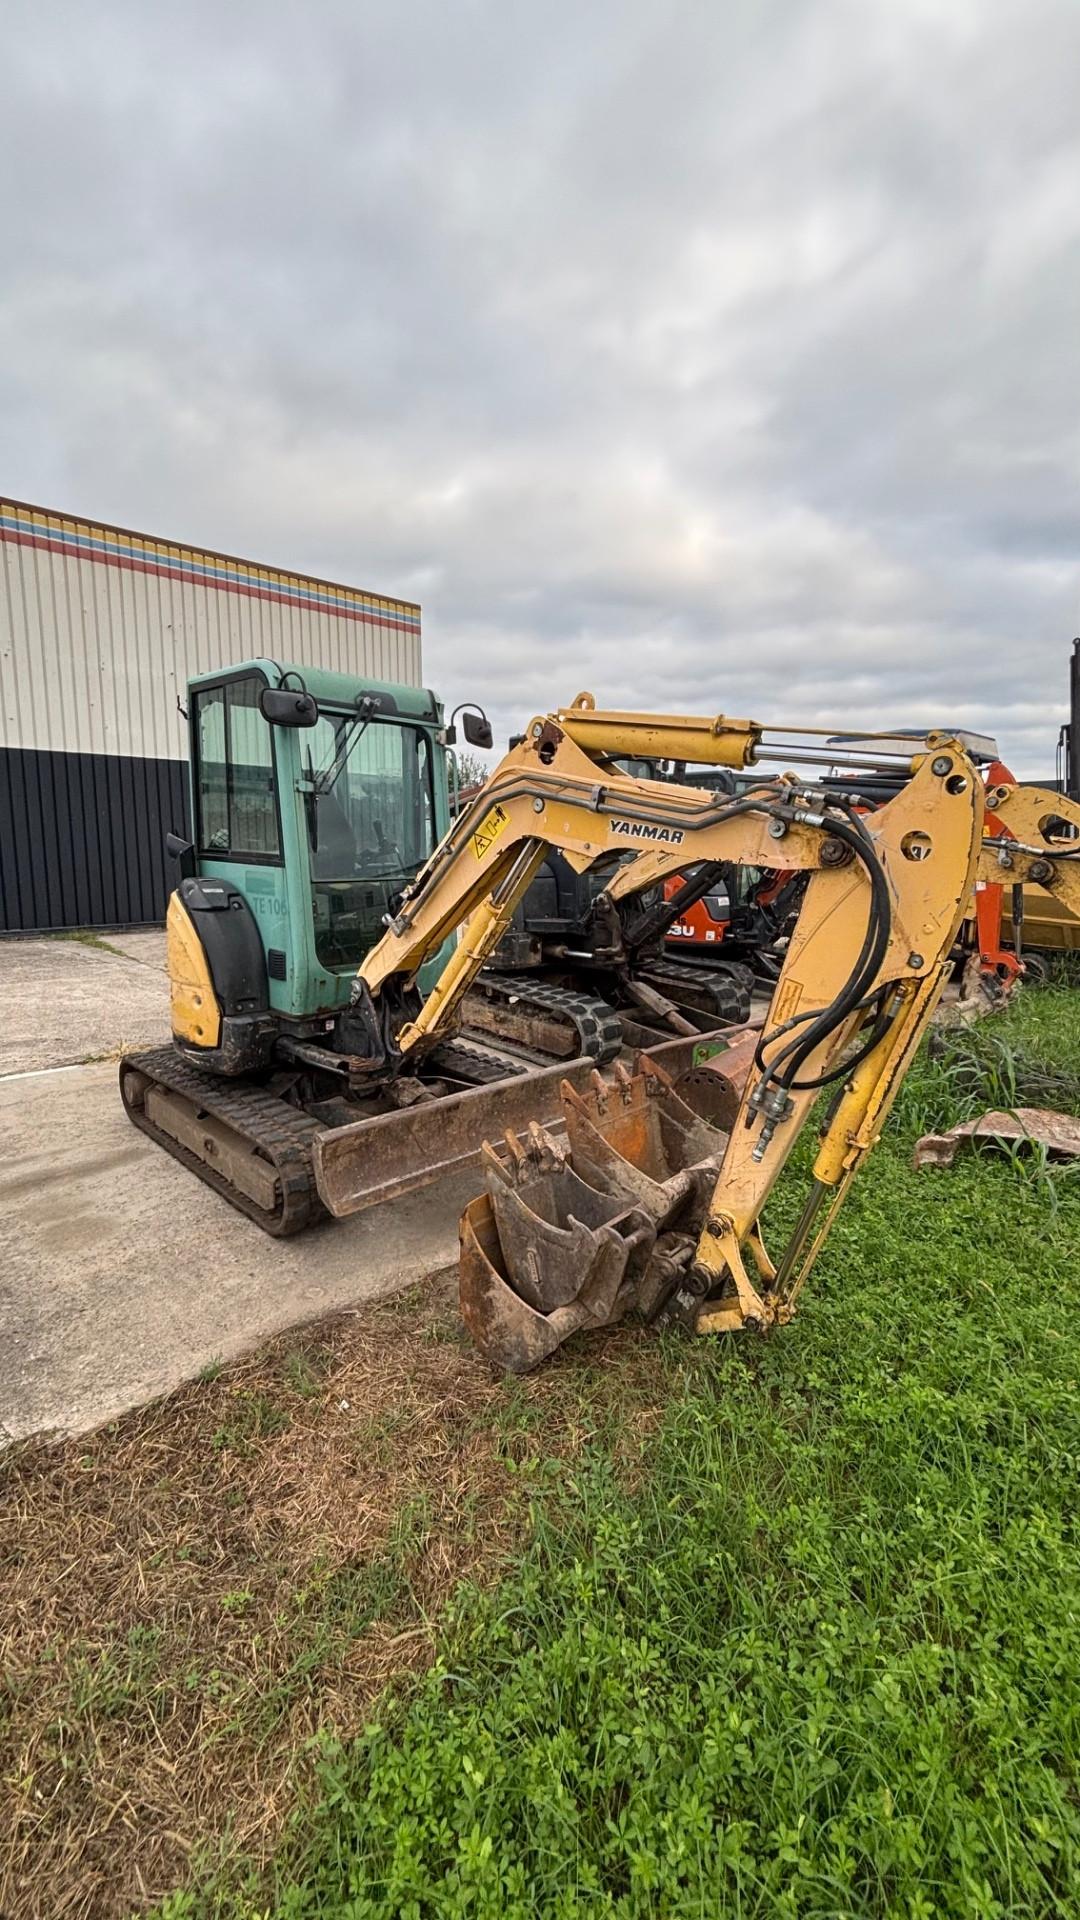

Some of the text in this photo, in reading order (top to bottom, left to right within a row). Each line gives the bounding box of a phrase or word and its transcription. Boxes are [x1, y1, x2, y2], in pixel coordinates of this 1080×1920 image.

[610, 820, 684, 844] YANMAR
[268, 898, 288, 916] 106
[667, 925, 695, 937] 3U
